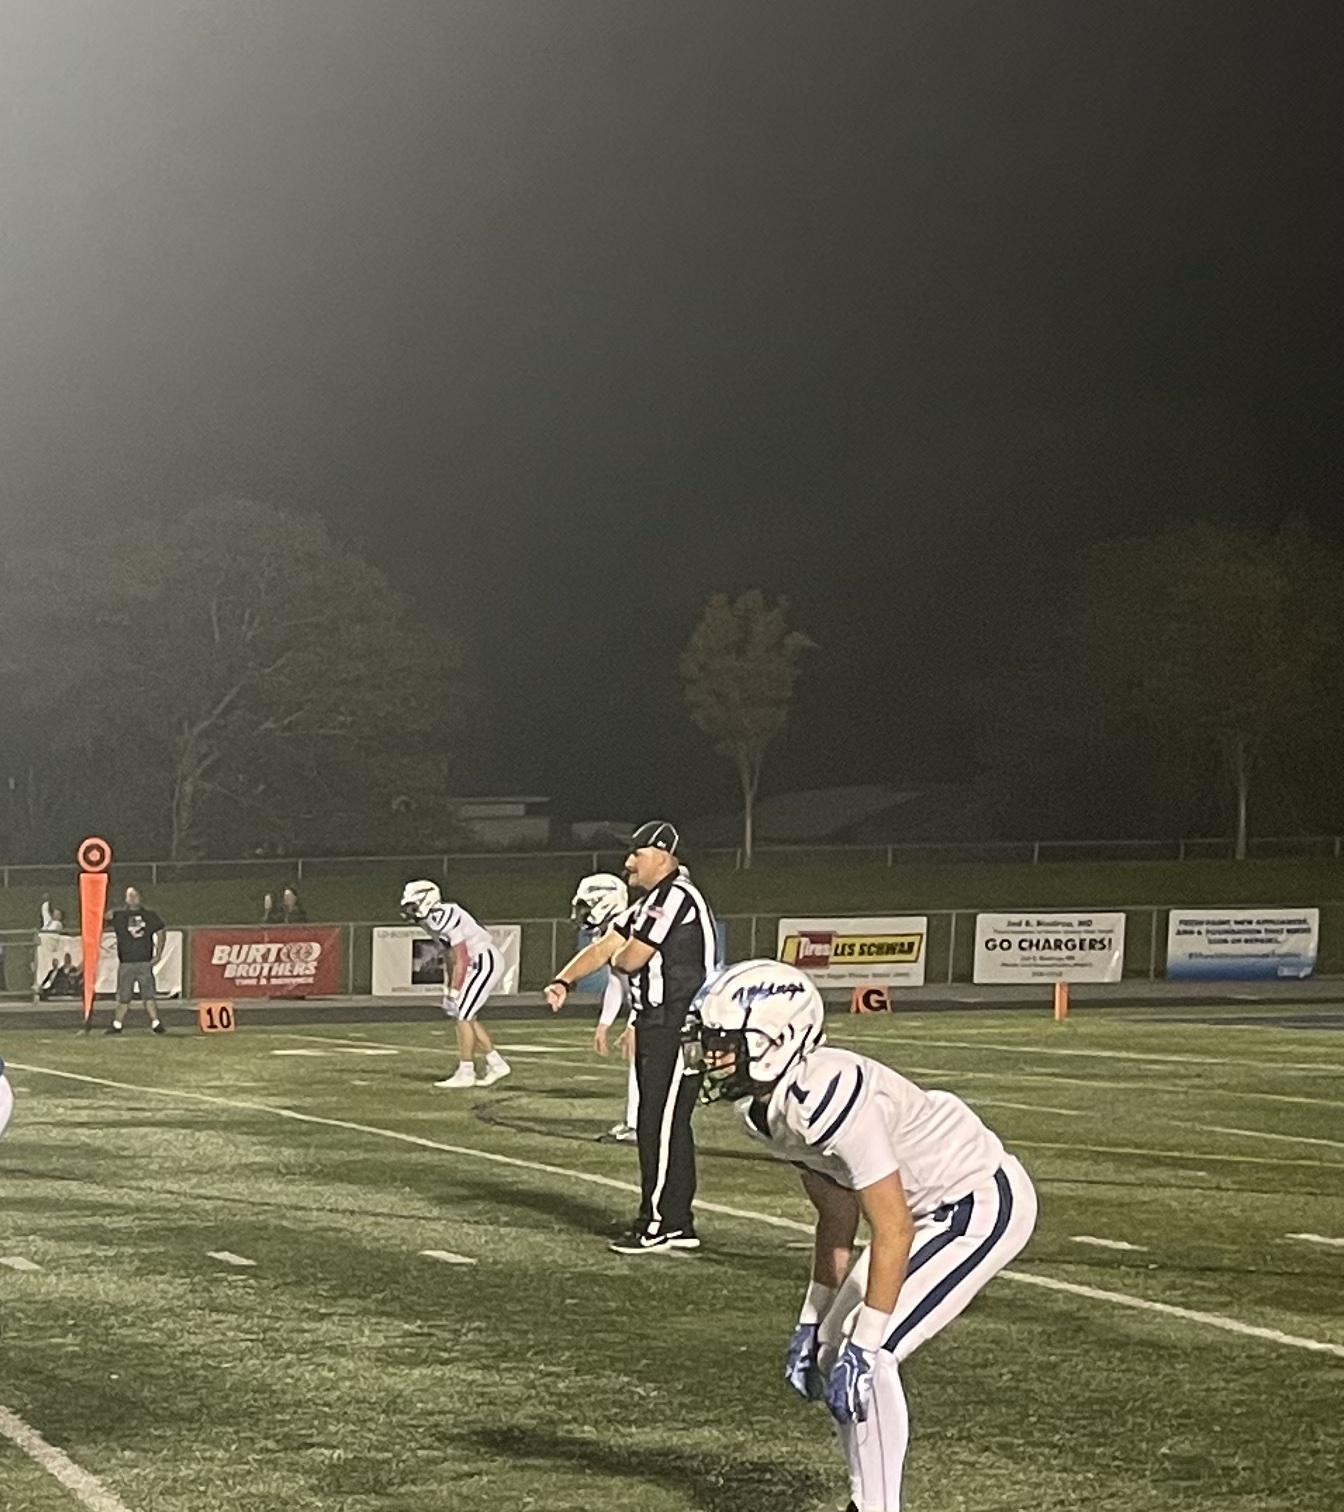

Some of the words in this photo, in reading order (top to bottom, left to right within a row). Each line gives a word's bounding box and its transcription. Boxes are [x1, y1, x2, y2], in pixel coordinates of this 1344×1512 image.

[833, 942, 856, 957] LES
[985, 938, 1012, 951] GO
[1018, 937, 1112, 951] CHARGERS!
[211, 943, 284, 965] BURT
[223, 962, 318, 978] BROTHERS
[862, 989, 888, 1011] G
[206, 1006, 231, 1029] 10
